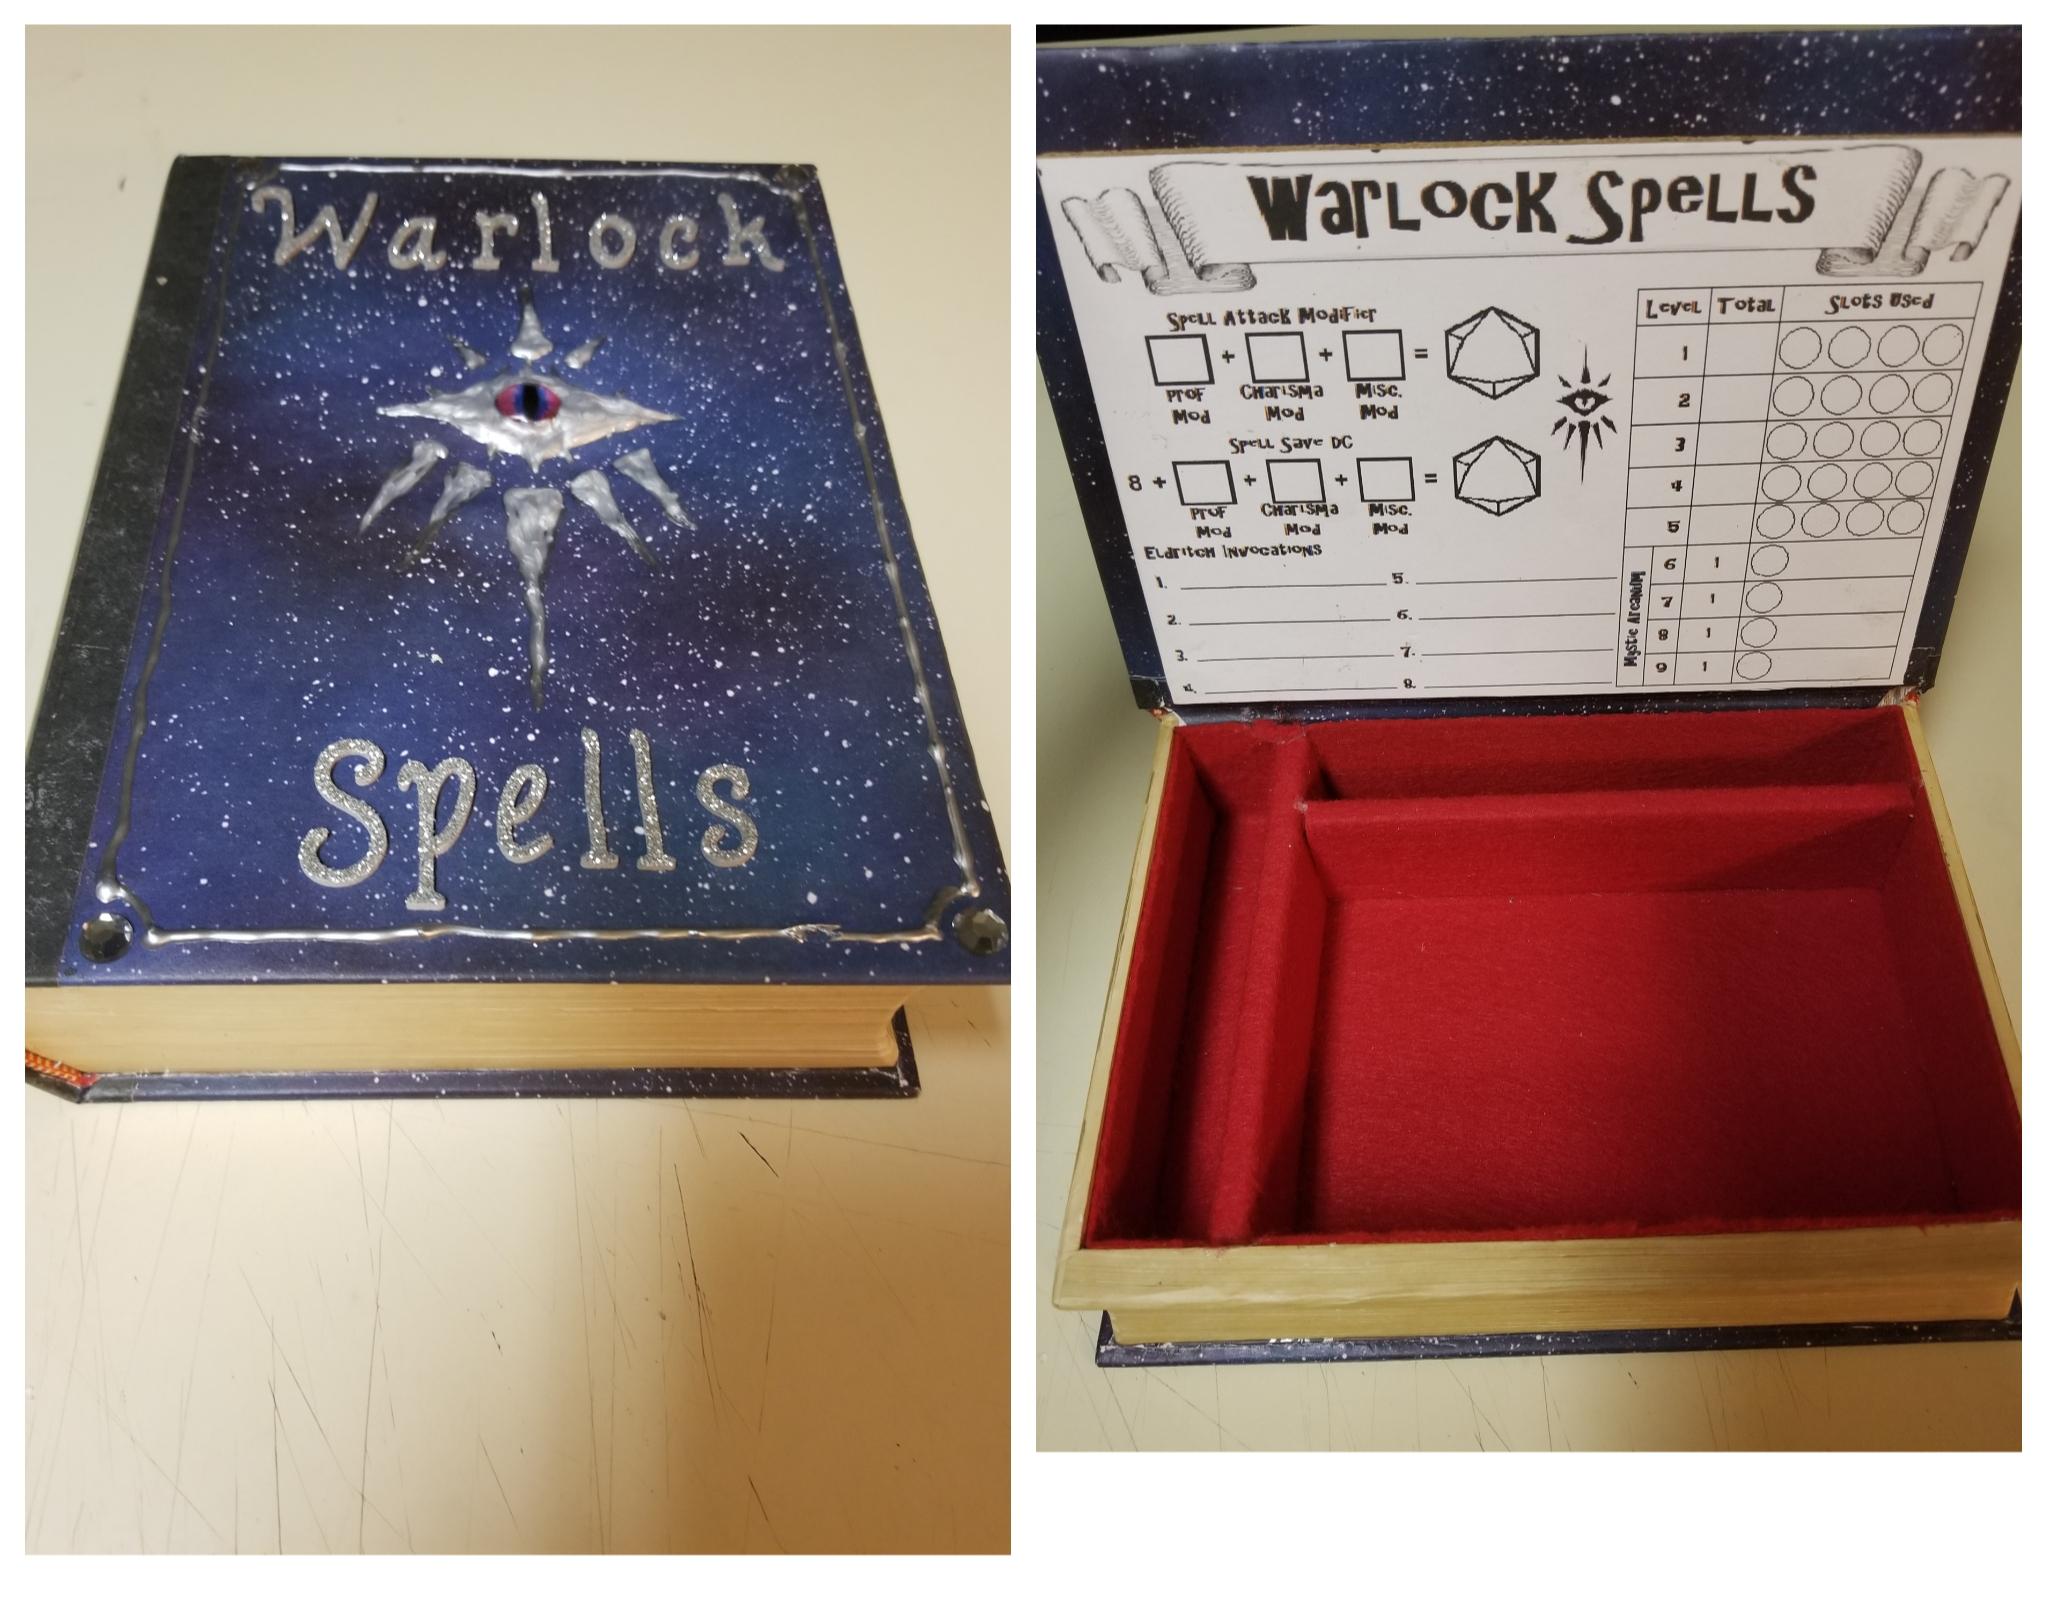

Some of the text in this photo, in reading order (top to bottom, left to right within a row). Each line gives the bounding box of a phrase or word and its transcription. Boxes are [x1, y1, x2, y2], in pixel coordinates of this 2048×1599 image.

[251, 186, 785, 272] Warlock
[1681, 345, 1689, 361] 1
[1678, 392, 1691, 409] 2
[1171, 408, 1211, 426] Mod
[1264, 405, 1305, 422] Mod
[1359, 403, 1399, 421] Mod
[1331, 434, 1354, 450] DC
[1674, 436, 1686, 453] 3
[1127, 474, 1143, 492] 8
[1670, 479, 1683, 493] 4
[1195, 525, 1233, 539] Mod
[1284, 522, 1322, 537] Mod
[1372, 522, 1409, 536] Mod
[1667, 519, 1681, 534] 5
[1663, 557, 1677, 571] 6
[1714, 556, 1720, 569] 1
[1391, 572, 1409, 585] 5.
[1660, 596, 1674, 609] 7
[1710, 592, 1716, 604] 1
[1166, 614, 1182, 626] 2.
[1396, 608, 1413, 621] 6.
[1657, 628, 1669, 641] 8
[1705, 627, 1711, 639] 1
[1655, 662, 1668, 674] 9
[1702, 660, 1708, 673] 1
[298, 728, 758, 910] Spells
